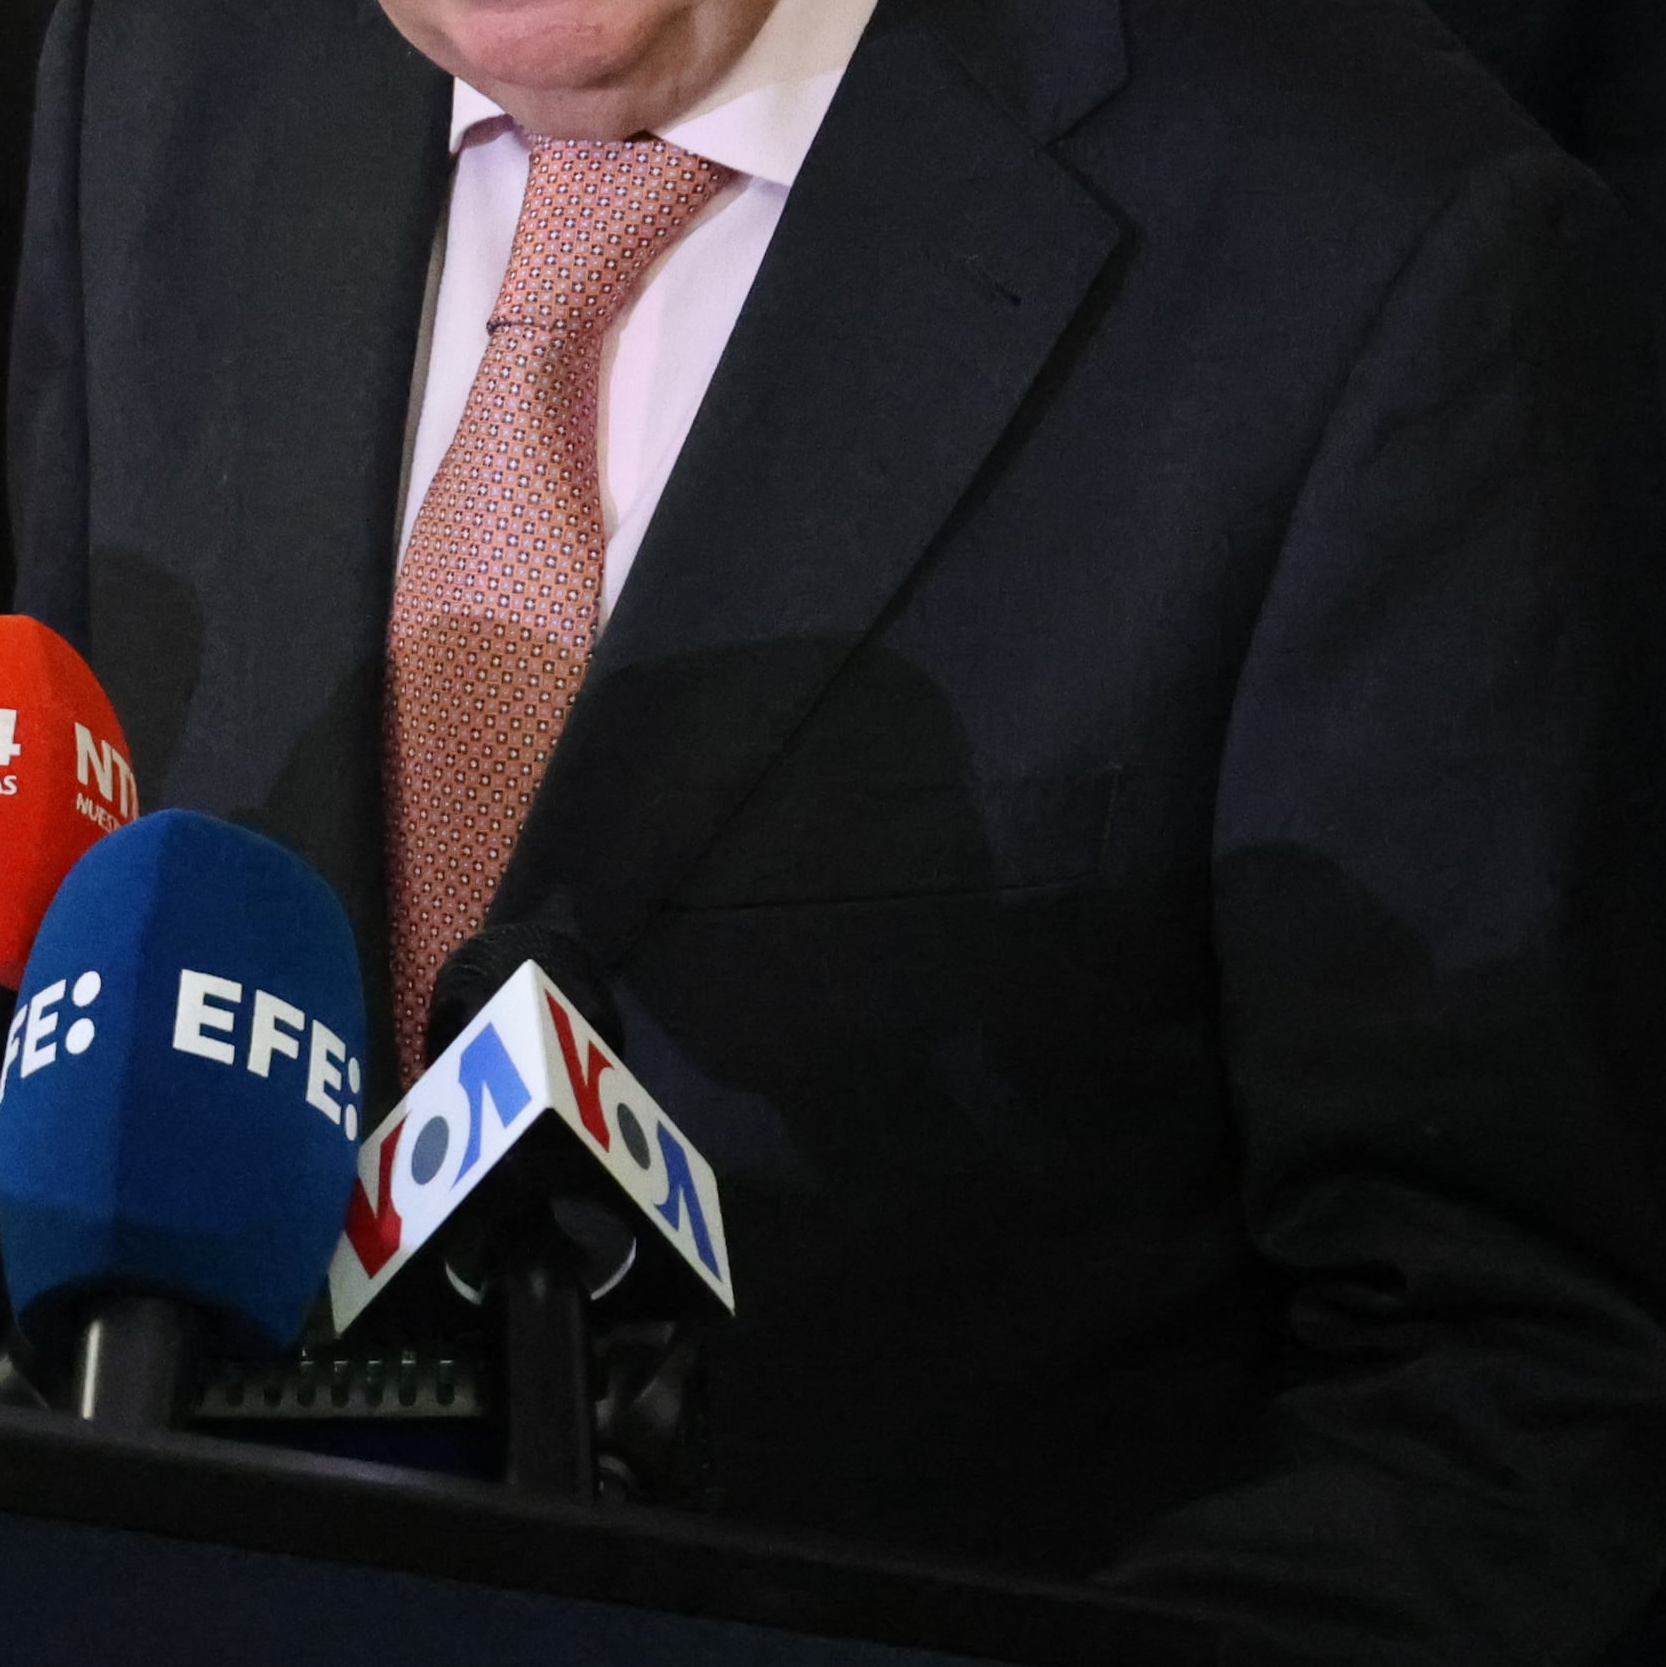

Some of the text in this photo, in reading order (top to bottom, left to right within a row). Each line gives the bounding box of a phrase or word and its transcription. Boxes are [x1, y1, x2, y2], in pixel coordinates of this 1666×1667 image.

[75, 722, 138, 821] NT
[173, 969, 361, 1141] EFE:
[345, 1021, 532, 1279] VOA
[545, 989, 721, 1283] VOA
